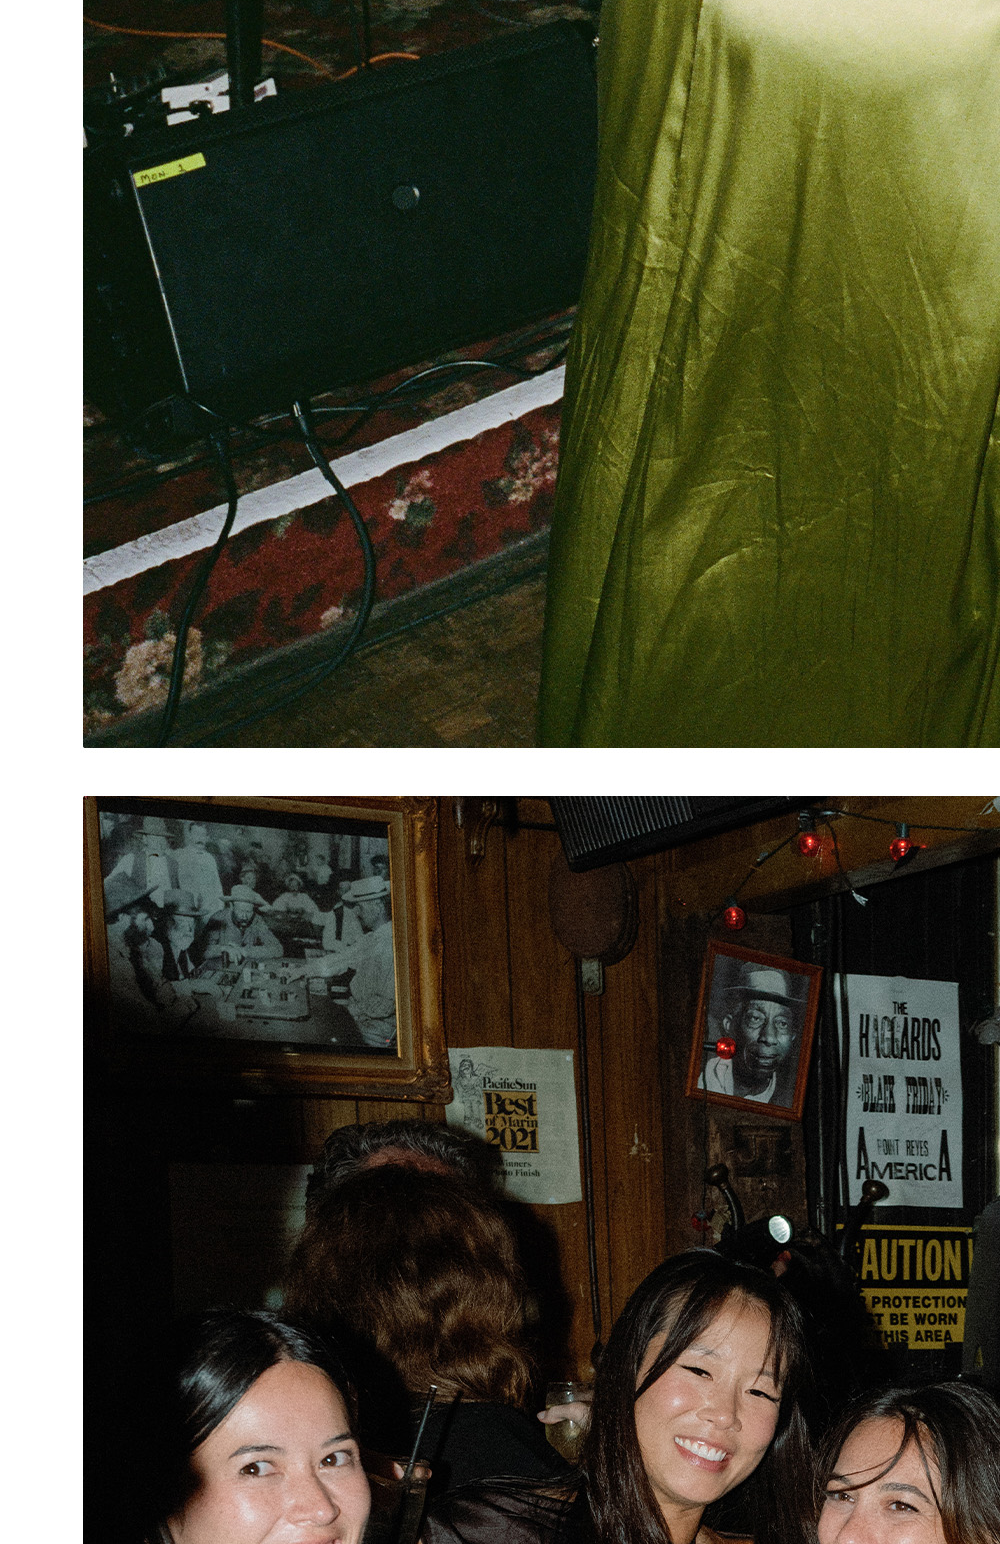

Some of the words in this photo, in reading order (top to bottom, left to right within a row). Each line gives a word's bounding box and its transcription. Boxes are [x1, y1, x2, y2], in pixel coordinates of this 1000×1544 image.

[140, 171, 166, 184] MON
[892, 1001, 909, 1015] THE
[859, 1013, 942, 1062] HAGGARDS
[904, 1075, 943, 1116] FRIDAY
[485, 1091, 538, 1117] Best
[485, 1116, 499, 1128] of
[501, 1116, 538, 1128] Marin
[486, 1127, 539, 1151] 2021
[856, 1126, 953, 1182] AMERICA
[905, 1139, 930, 1157] REYES
[515, 1169, 541, 1177] Finish
[855, 1238, 963, 1281] AUTION
[871, 1295, 967, 1309] PROTECTION
[889, 1313, 909, 1326] BE
[914, 1313, 958, 1326] WORN
[914, 1330, 954, 1343] AREA
